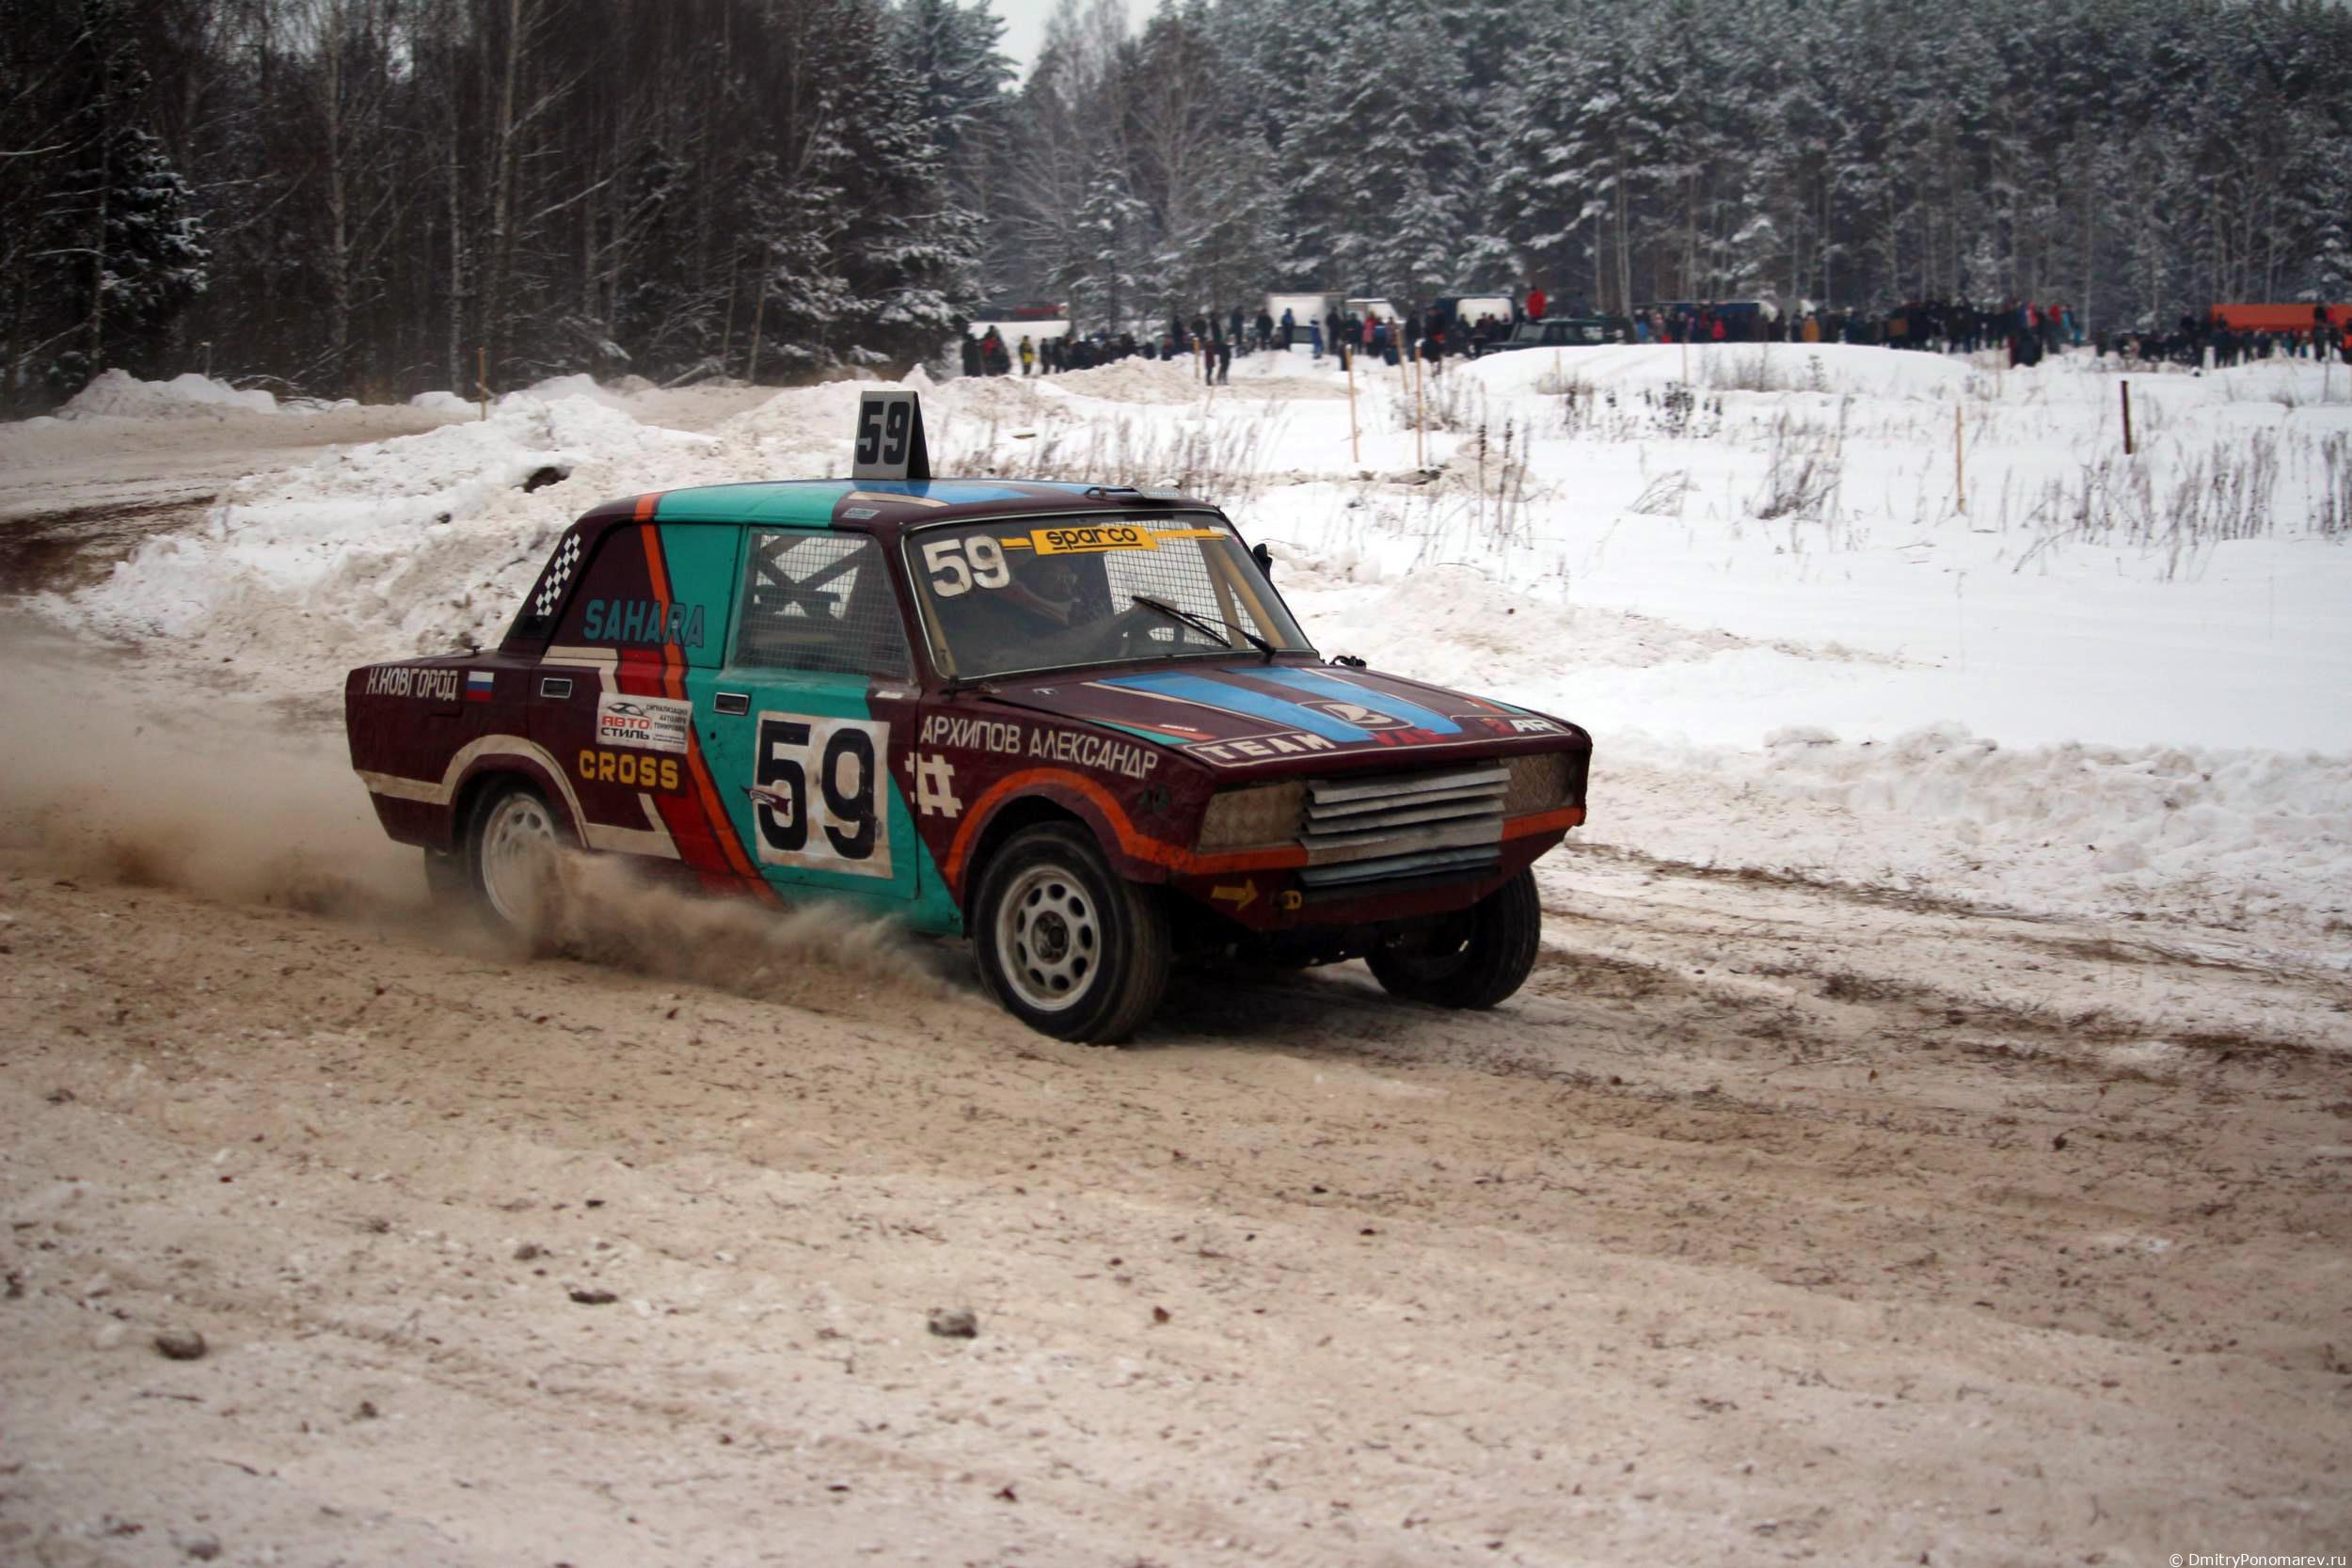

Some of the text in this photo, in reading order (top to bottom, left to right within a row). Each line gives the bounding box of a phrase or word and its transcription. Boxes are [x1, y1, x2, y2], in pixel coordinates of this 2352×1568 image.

[856, 401, 911, 466] 59
[1045, 526, 1137, 550] sparco
[922, 534, 1010, 598] 59
[583, 599, 705, 648] SAHARA
[601, 727, 650, 740] СТИЛЬ
[602, 715, 651, 730] АВТО
[919, 714, 1159, 780] АРХИПОВ АЛЕКСАНДР
[1196, 734, 1337, 760] TEAM
[579, 750, 679, 790] CROSS
[755, 719, 877, 861] 59
